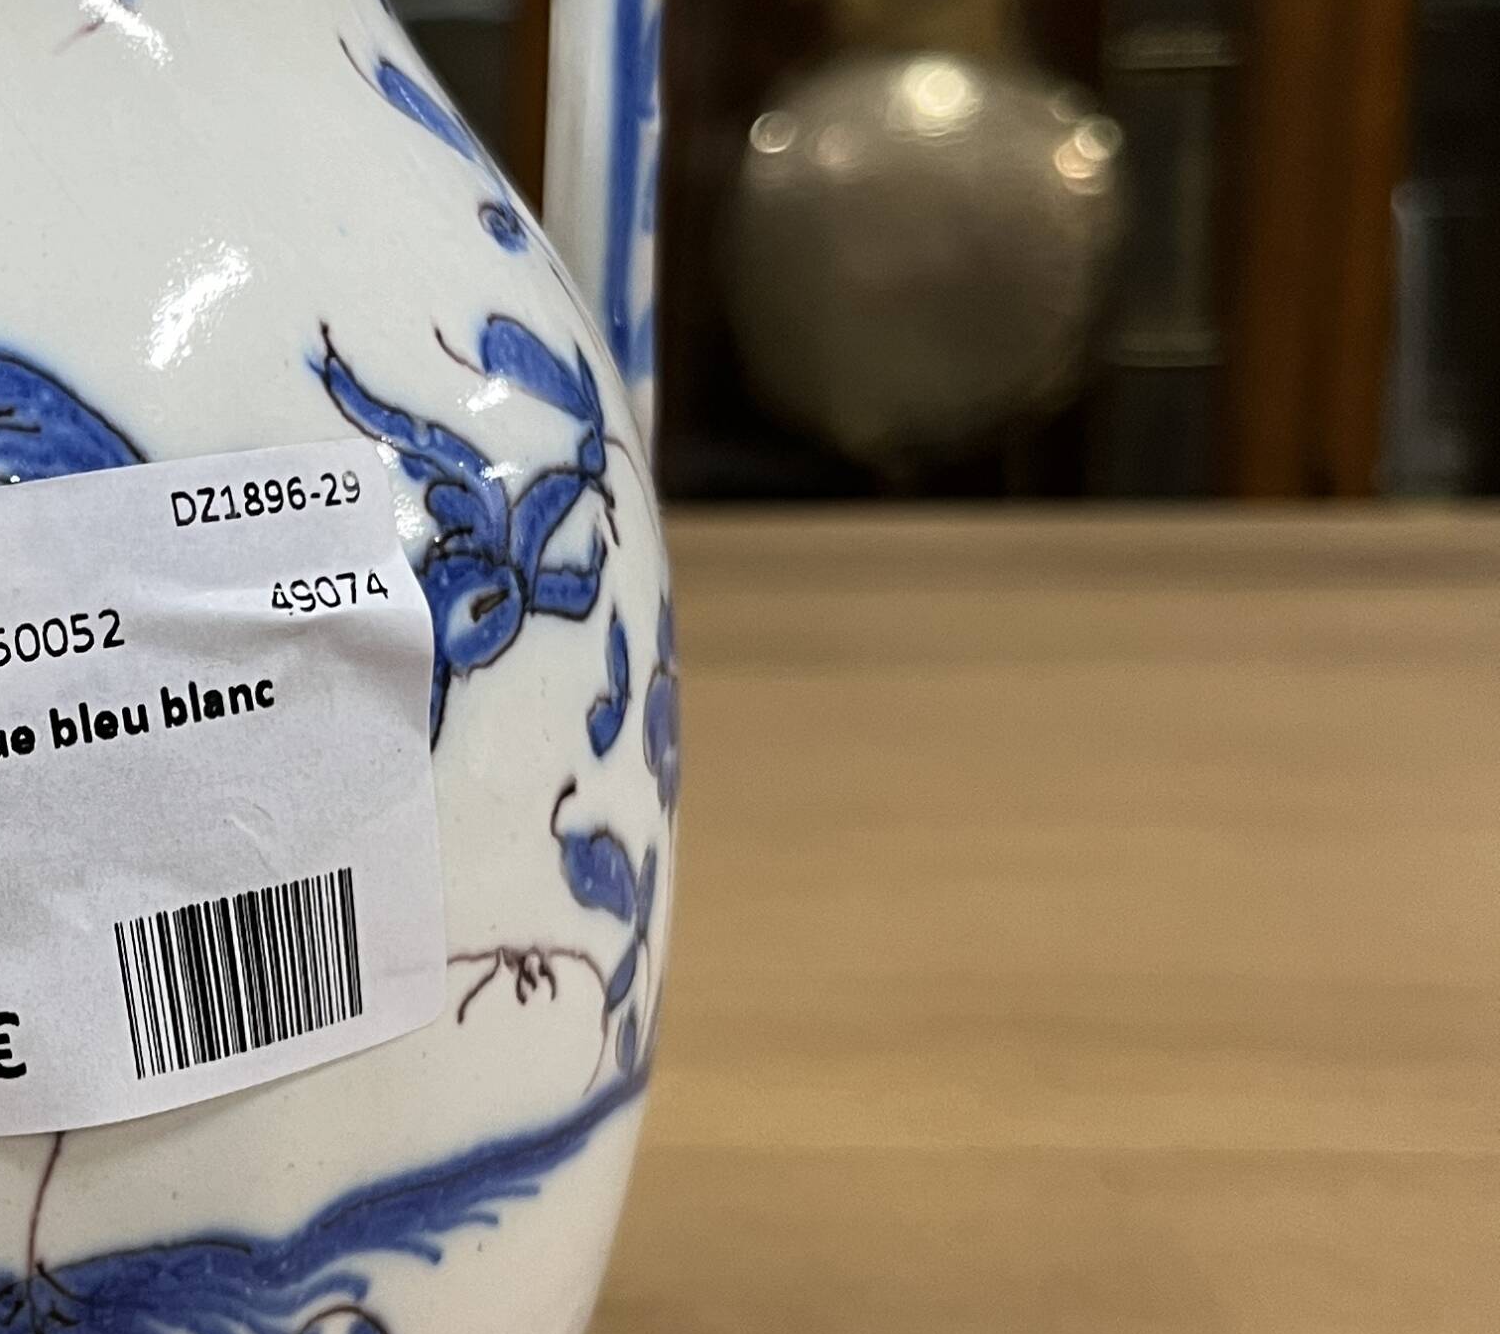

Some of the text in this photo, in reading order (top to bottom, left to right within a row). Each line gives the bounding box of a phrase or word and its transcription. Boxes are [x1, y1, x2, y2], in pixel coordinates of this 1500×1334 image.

[171, 470, 361, 527] DZ1896-29
[271, 569, 389, 615] 49074
[49, 701, 151, 751] bleu
[160, 678, 276, 729] blanc
